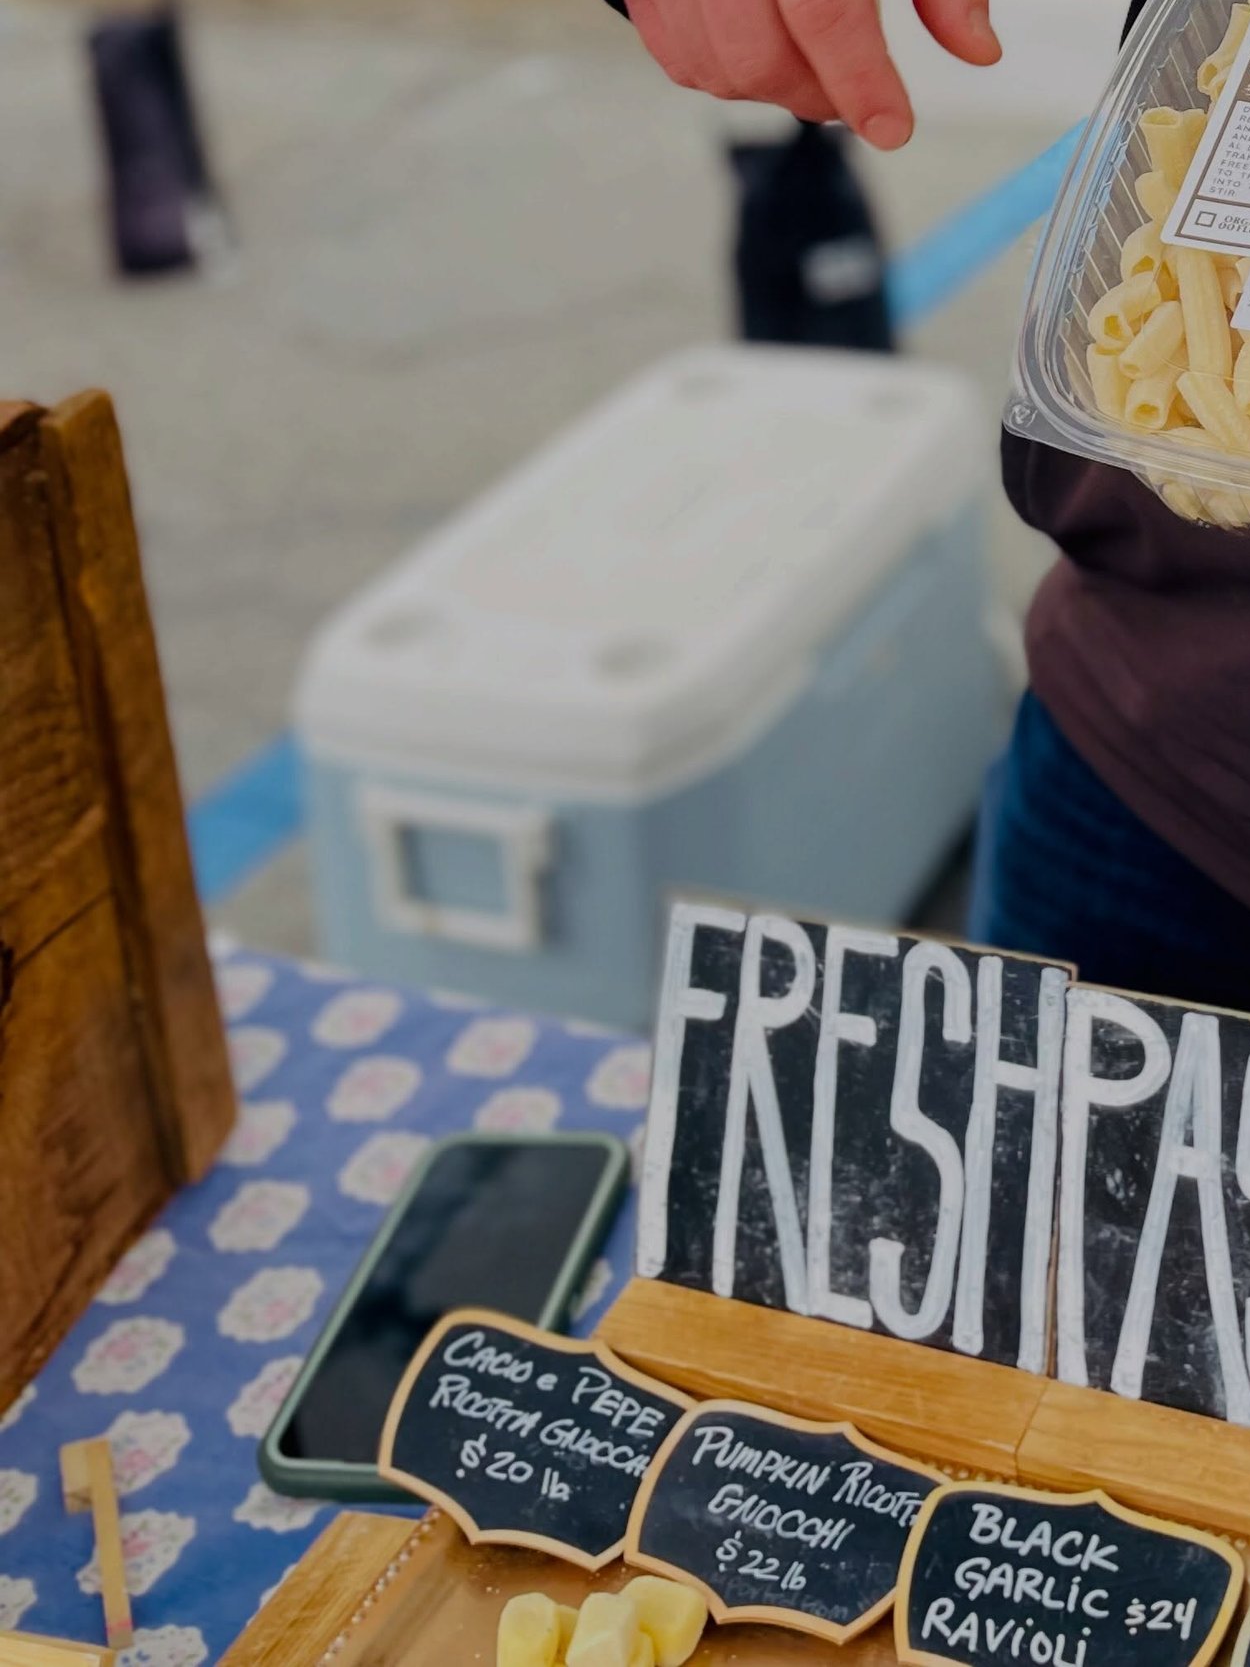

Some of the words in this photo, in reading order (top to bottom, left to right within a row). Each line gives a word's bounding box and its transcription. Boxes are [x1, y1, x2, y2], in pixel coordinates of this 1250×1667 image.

[1212, 177, 1242, 187] INTO
[637, 902, 1069, 1374] FRESH
[429, 1374, 542, 1437] RICOTTA
[539, 1419, 650, 1479] GNOCCH
[444, 1331, 533, 1383] CACIO
[536, 1373, 558, 1391] e
[572, 1366, 665, 1437] PEPE
[692, 1426, 831, 1495] PUMPKIN
[832, 1461, 924, 1528] RICOTT
[708, 1483, 855, 1551] GNOCCHI
[969, 1503, 1119, 1573] BLACK
[1124, 1598, 1198, 1641] $24
